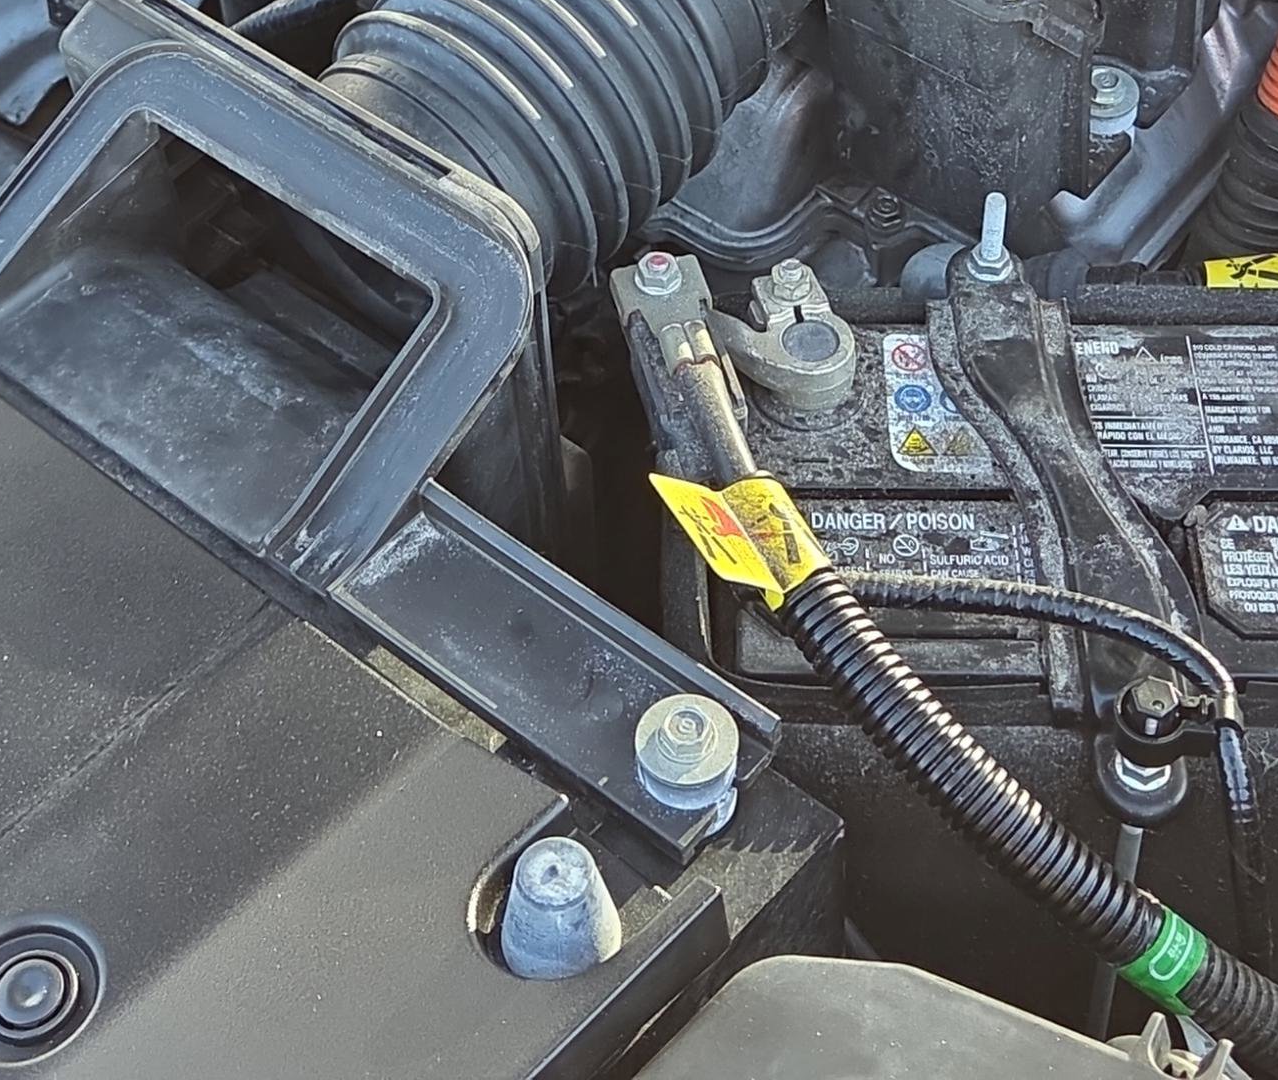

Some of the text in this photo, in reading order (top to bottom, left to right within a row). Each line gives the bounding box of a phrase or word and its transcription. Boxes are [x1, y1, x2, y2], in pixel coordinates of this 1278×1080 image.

[1075, 341, 1119, 355] ENENO
[1252, 436, 1263, 444] CA
[811, 513, 885, 530] DANGER
[906, 513, 975, 530] POISON
[1220, 538, 1235, 549] SE
[879, 553, 896, 564] NO
[930, 554, 1009, 566] SULFURIC ACID
[1224, 564, 1243, 575] LES
